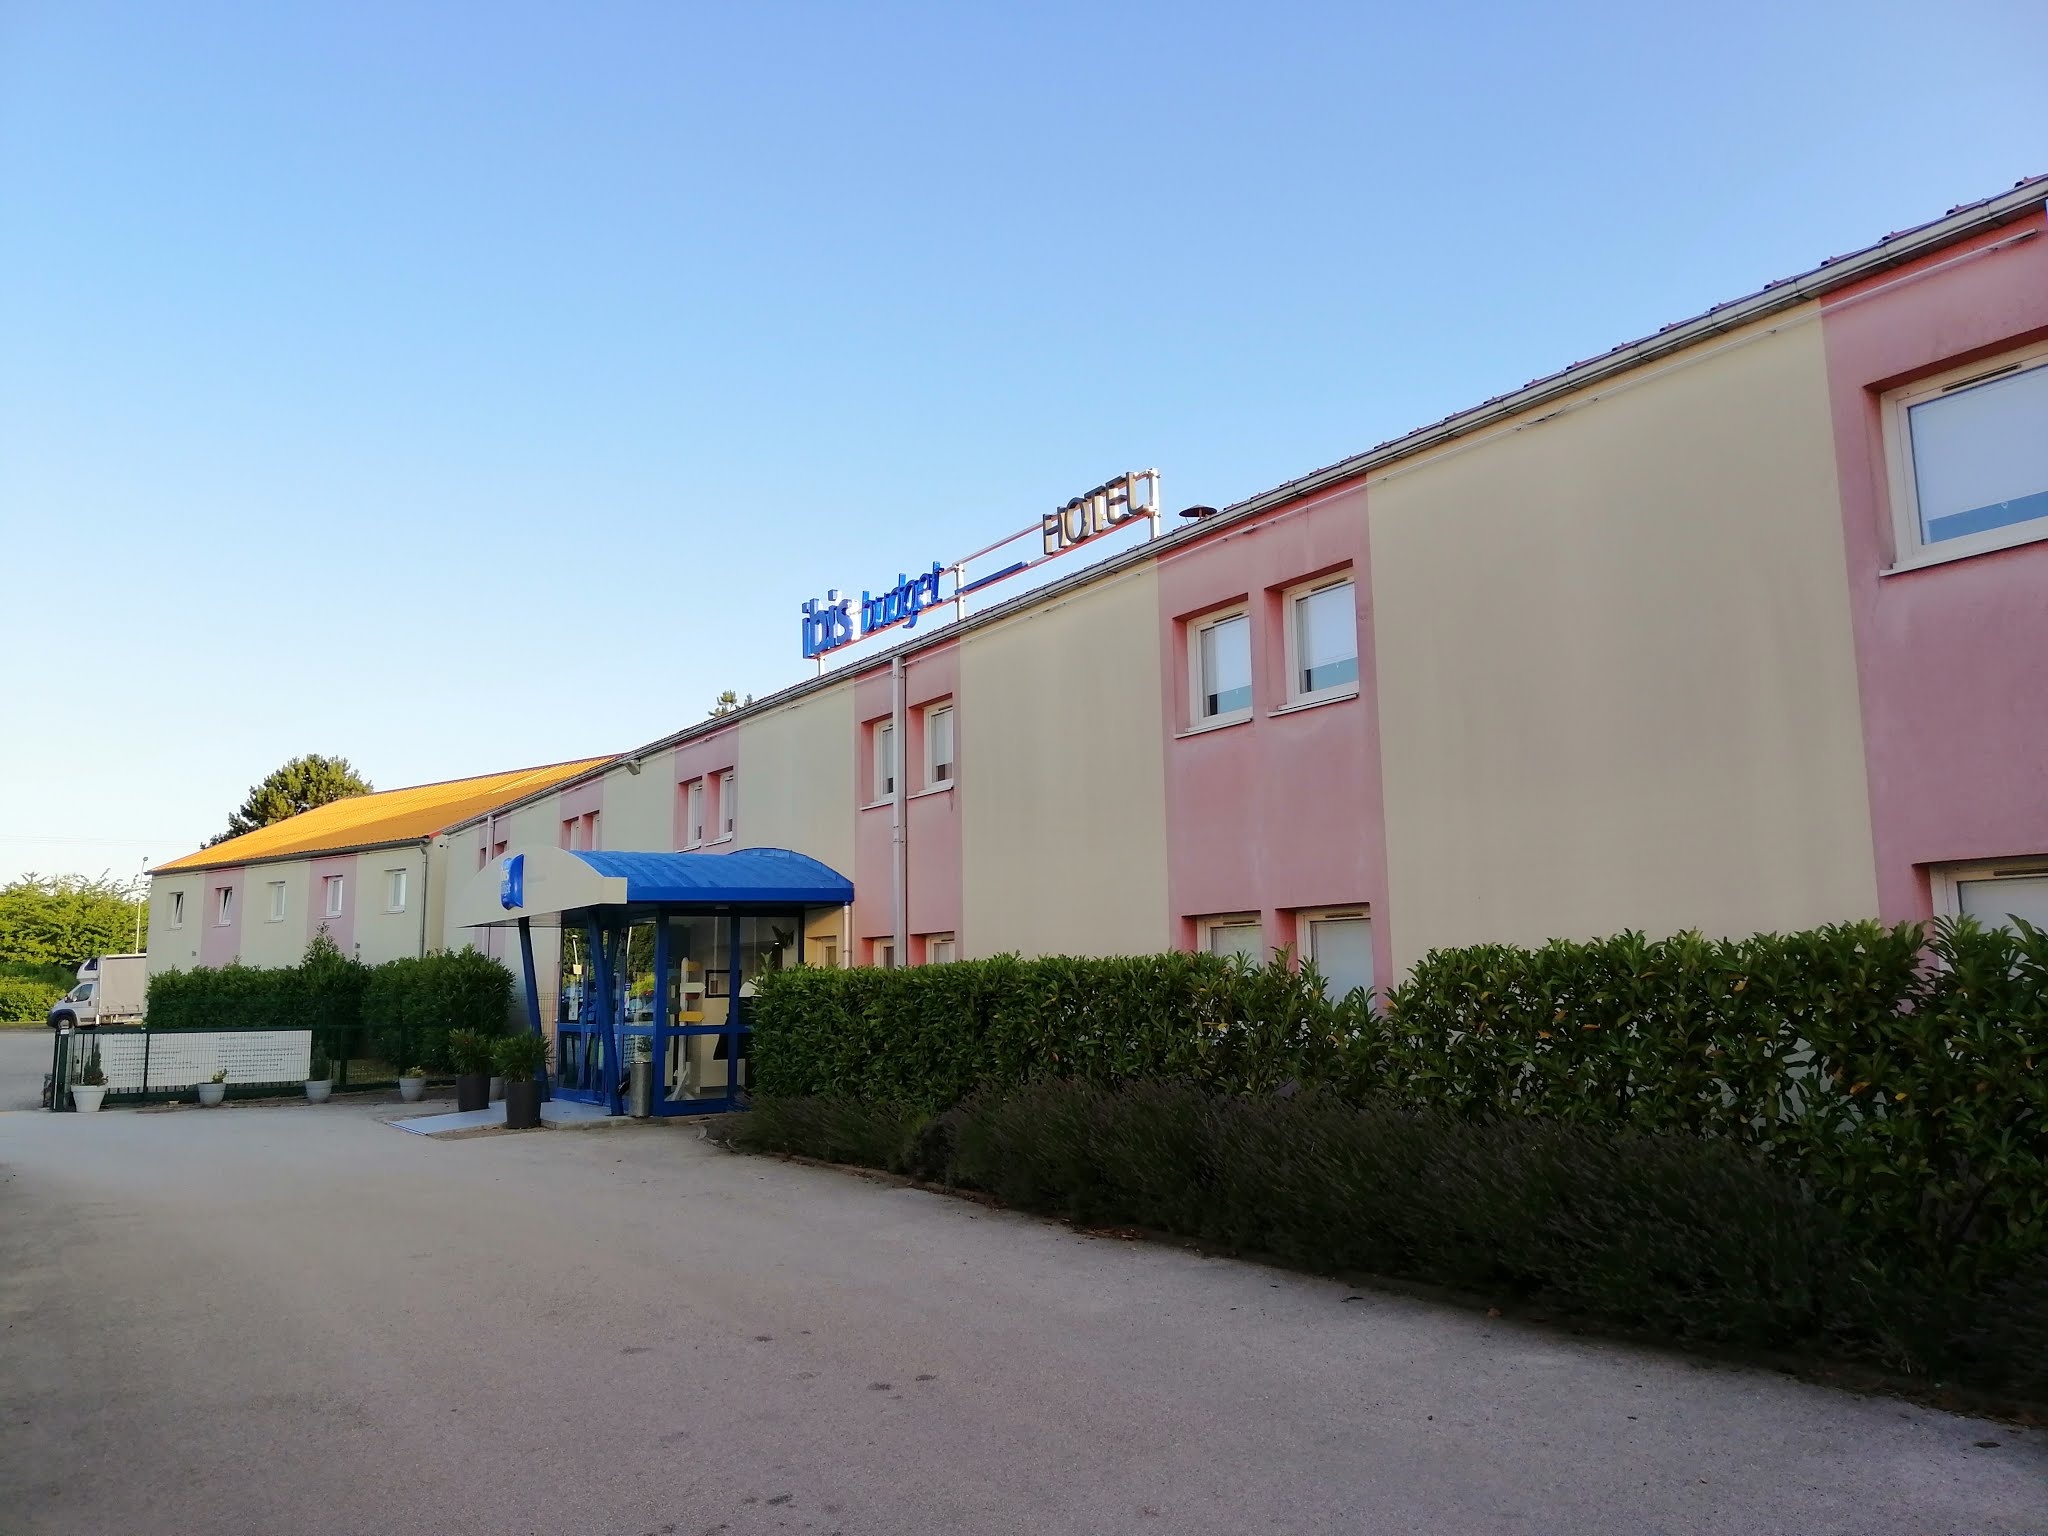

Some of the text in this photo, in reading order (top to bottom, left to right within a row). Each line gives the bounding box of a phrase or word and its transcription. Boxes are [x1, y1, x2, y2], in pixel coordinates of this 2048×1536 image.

[1043, 472, 1145, 555] HOTEL
[801, 561, 944, 659] ibis budget
